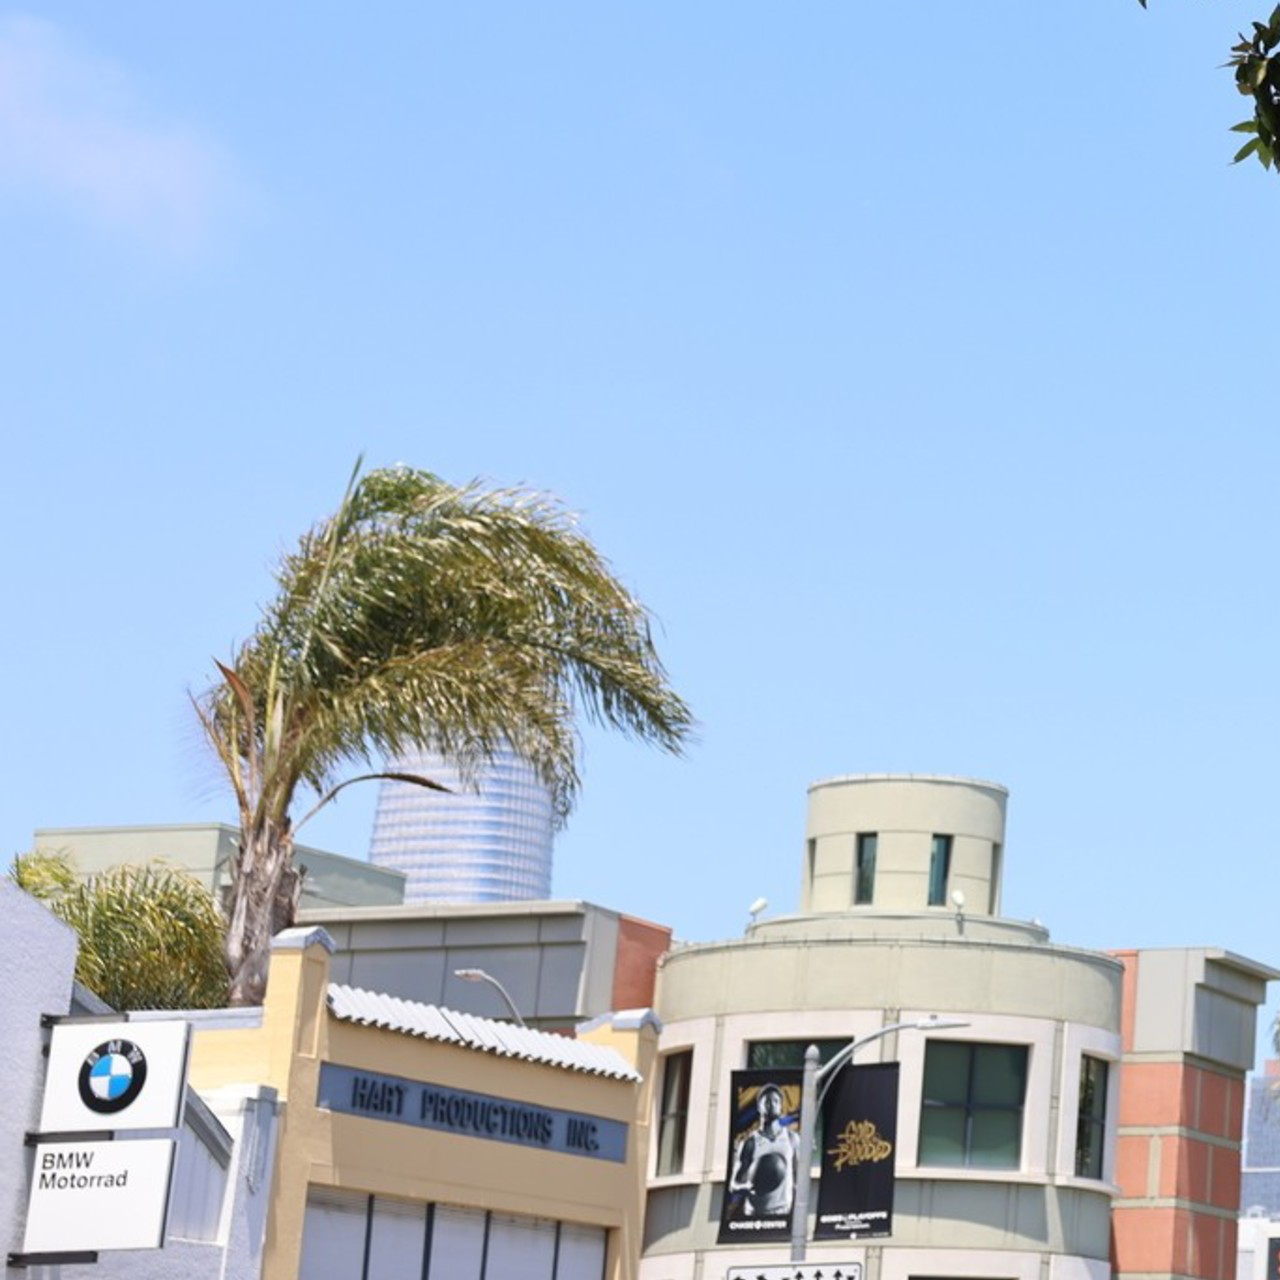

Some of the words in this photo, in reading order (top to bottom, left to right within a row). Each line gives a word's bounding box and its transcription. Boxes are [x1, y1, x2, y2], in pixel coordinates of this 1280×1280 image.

[352, 1076, 408, 1116] HART
[420, 1088, 553, 1144] PRODUCTIONS
[42, 1152, 94, 1171] BMW
[39, 1170, 128, 1190] Motorrad
